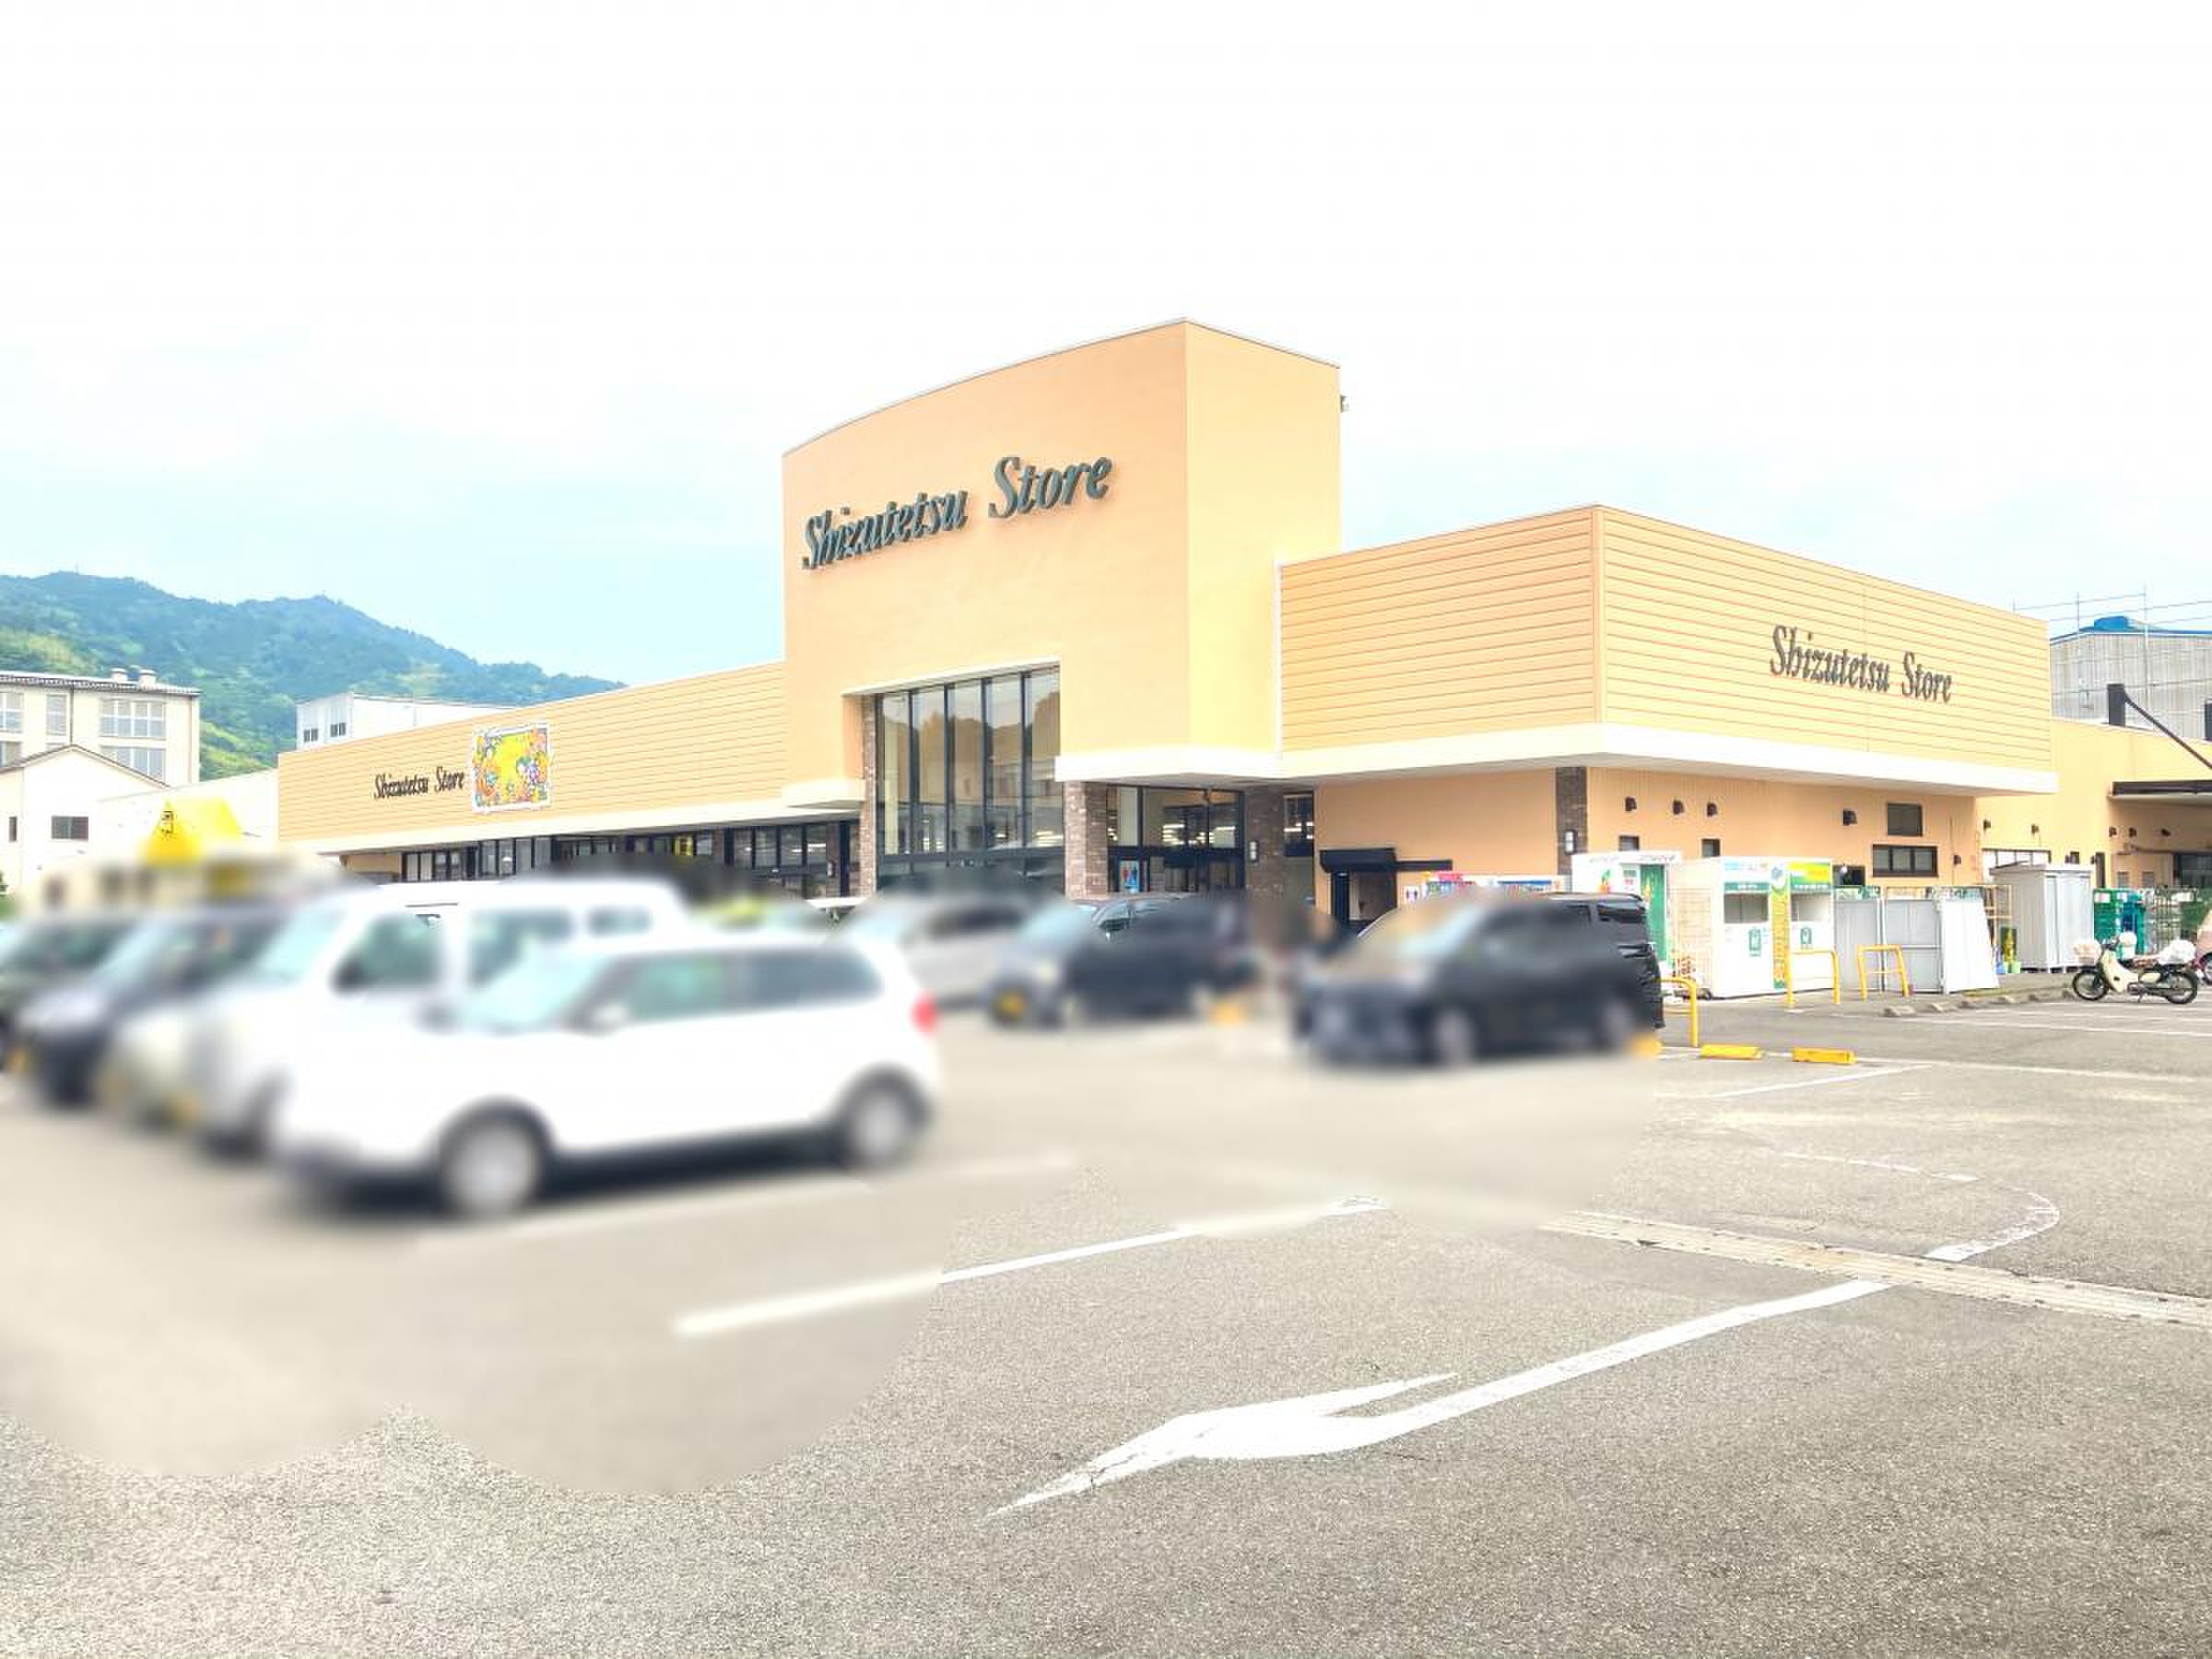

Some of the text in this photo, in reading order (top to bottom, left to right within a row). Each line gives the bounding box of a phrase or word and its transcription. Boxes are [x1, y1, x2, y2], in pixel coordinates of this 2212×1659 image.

[801, 455, 1112, 570] Shizutetsu Store
[1770, 624, 1951, 702] Shizutetsu Store
[374, 766, 465, 798] Shizutetsu Store
